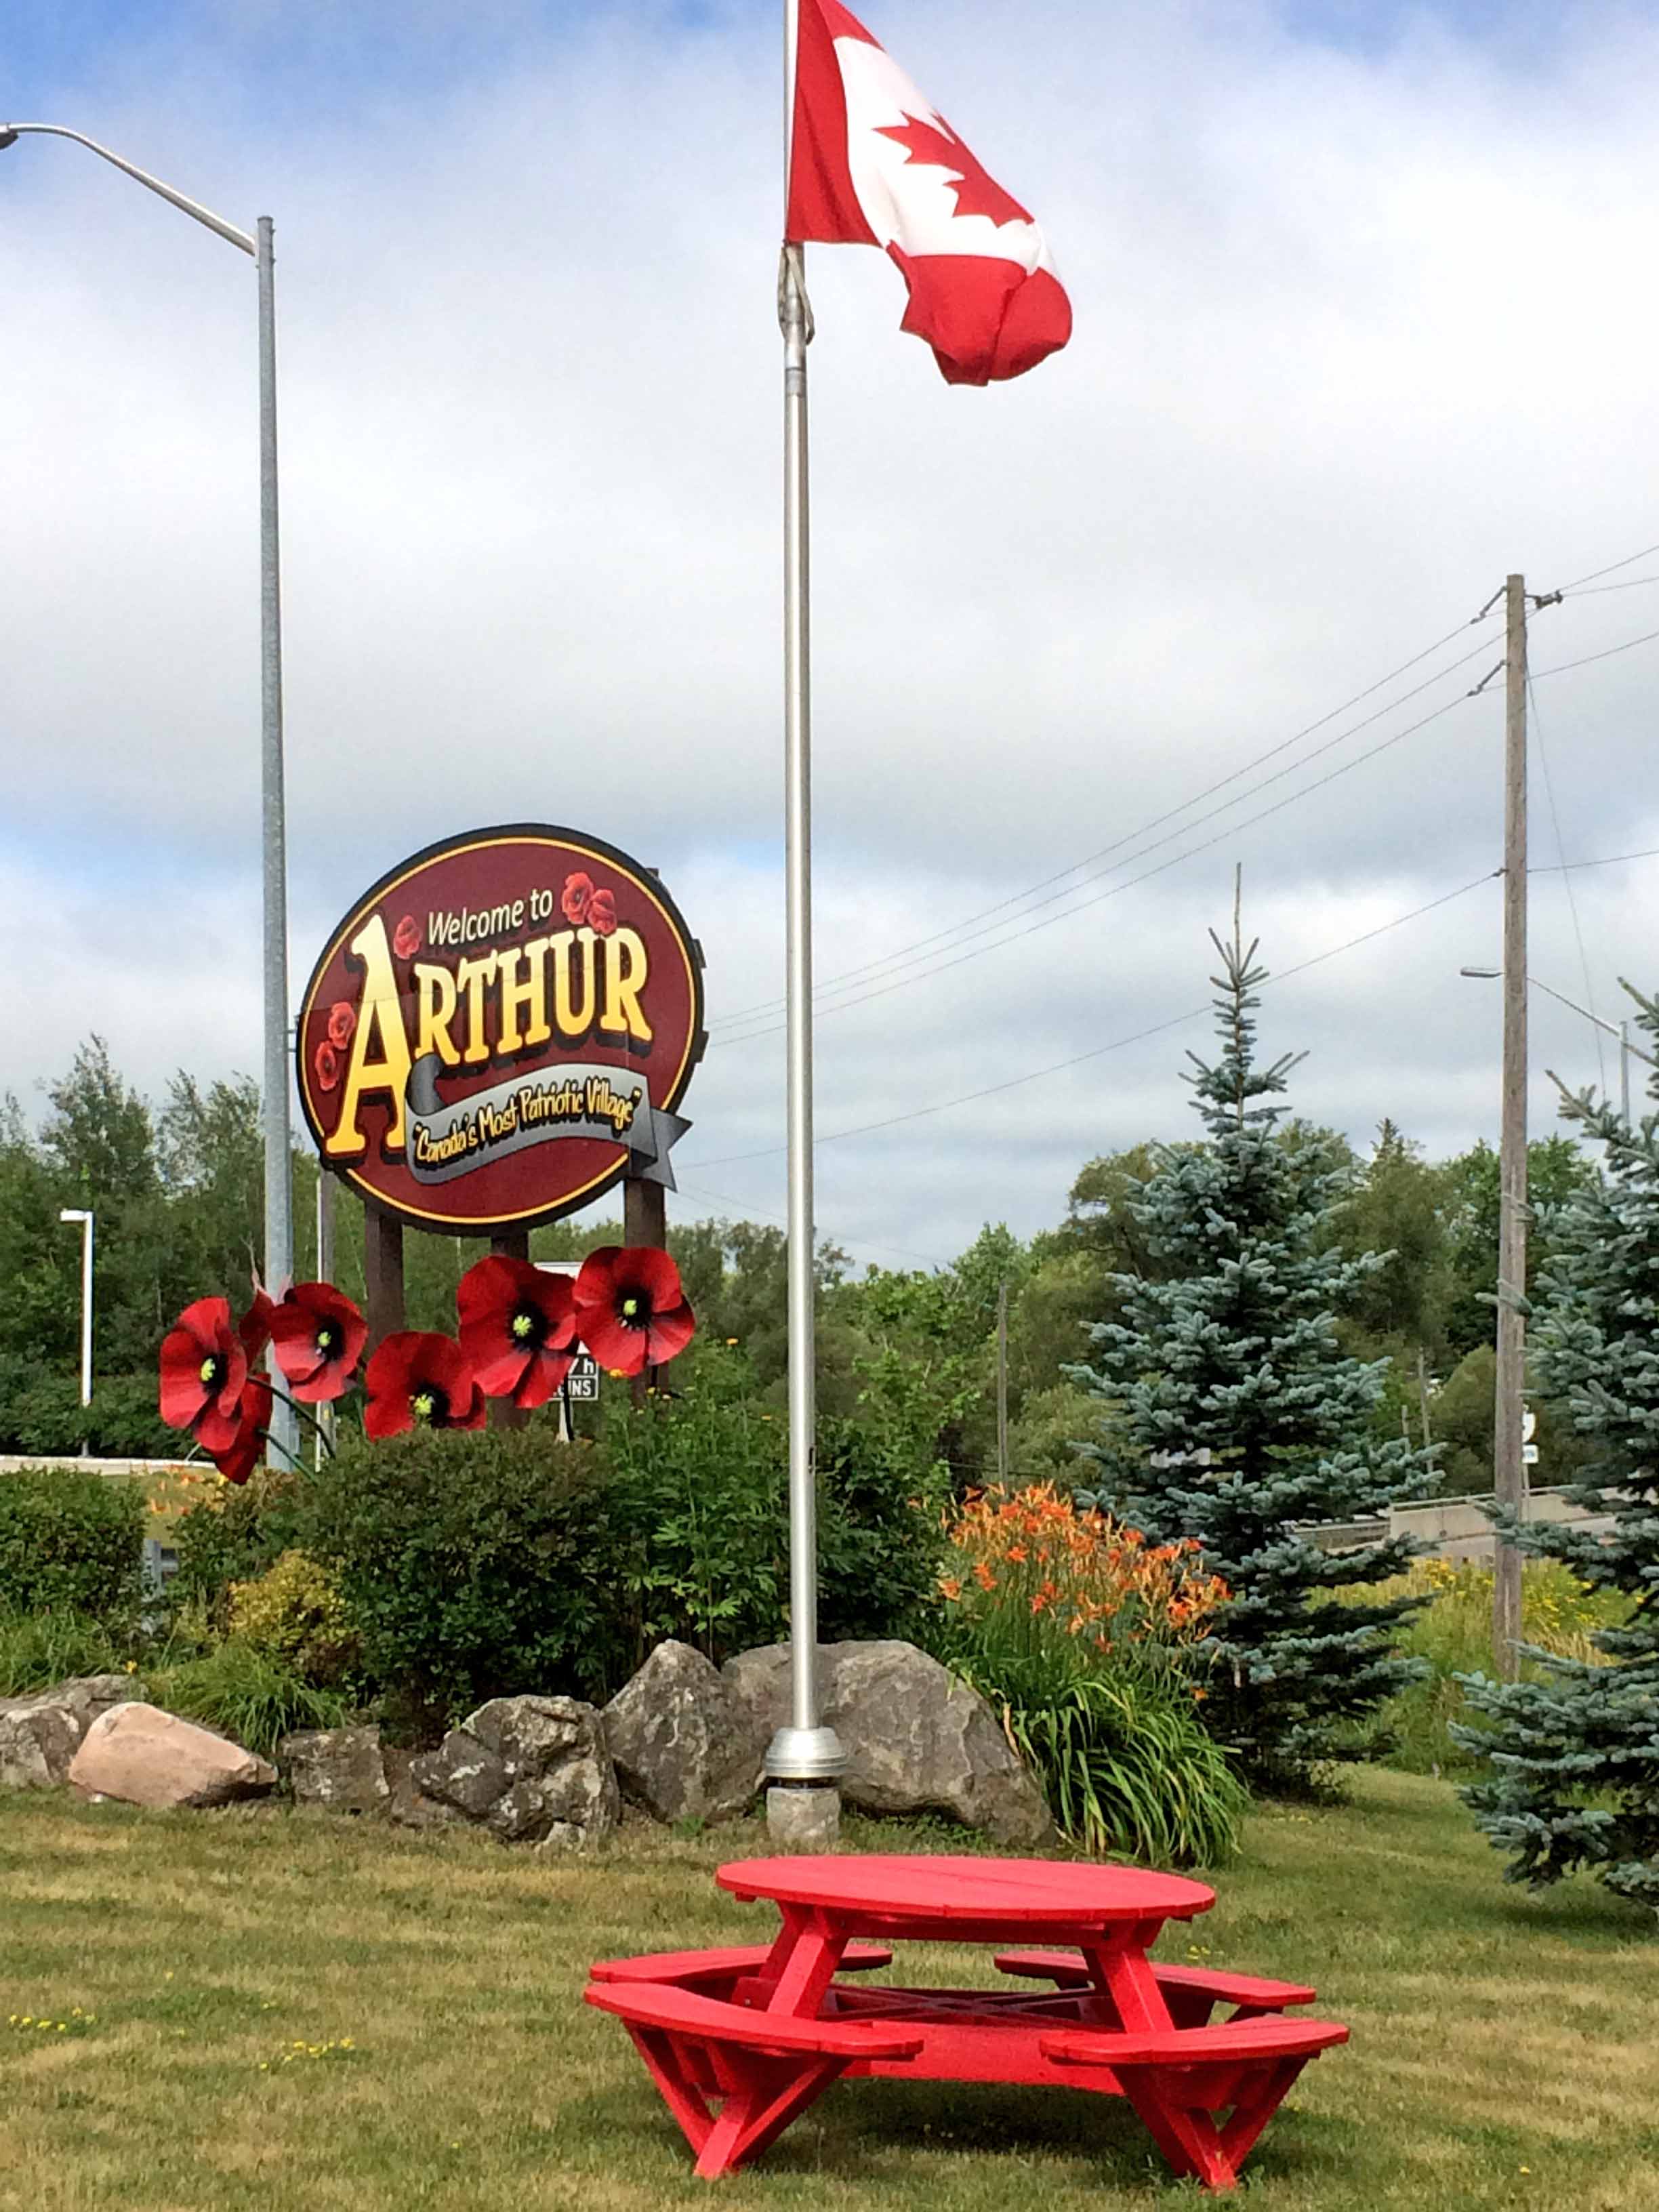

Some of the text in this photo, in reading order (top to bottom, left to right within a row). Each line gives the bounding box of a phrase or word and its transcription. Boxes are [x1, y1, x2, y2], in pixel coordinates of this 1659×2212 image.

[428, 888, 553, 945] Welcome to
[326, 914, 653, 1153] ARTHUR
[478, 1097, 518, 1140] Most
[519, 1082, 583, 1123] Patriotic
